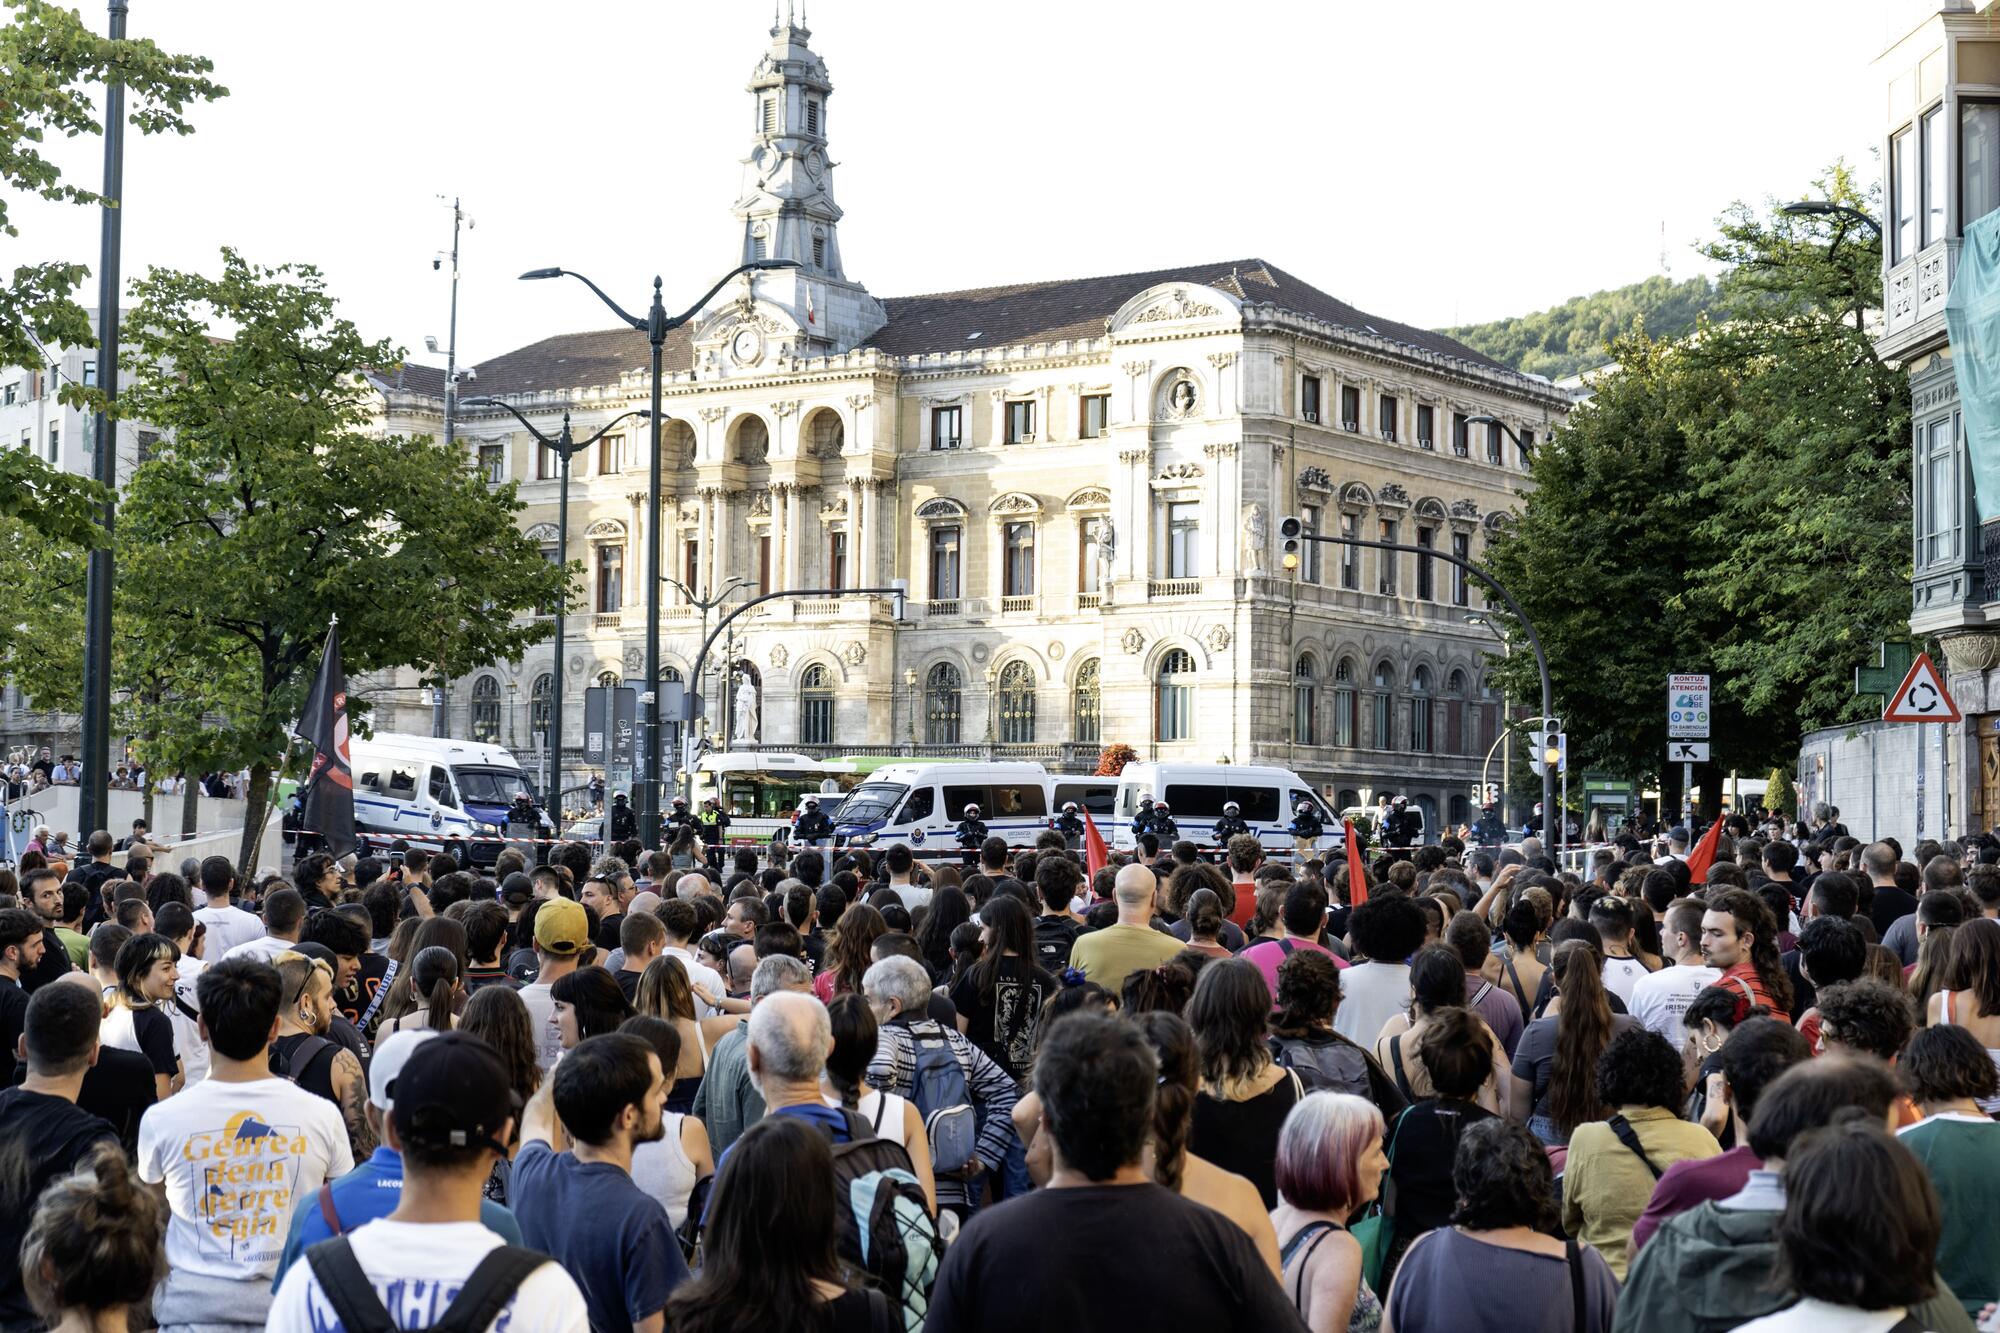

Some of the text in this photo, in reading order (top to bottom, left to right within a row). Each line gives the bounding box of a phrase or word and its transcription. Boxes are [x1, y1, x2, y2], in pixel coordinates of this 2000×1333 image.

[183, 1134, 308, 1162] Geurea
[207, 1160, 284, 1185] dena
[199, 1187, 289, 1217] geure
[211, 1211, 278, 1242] egin
